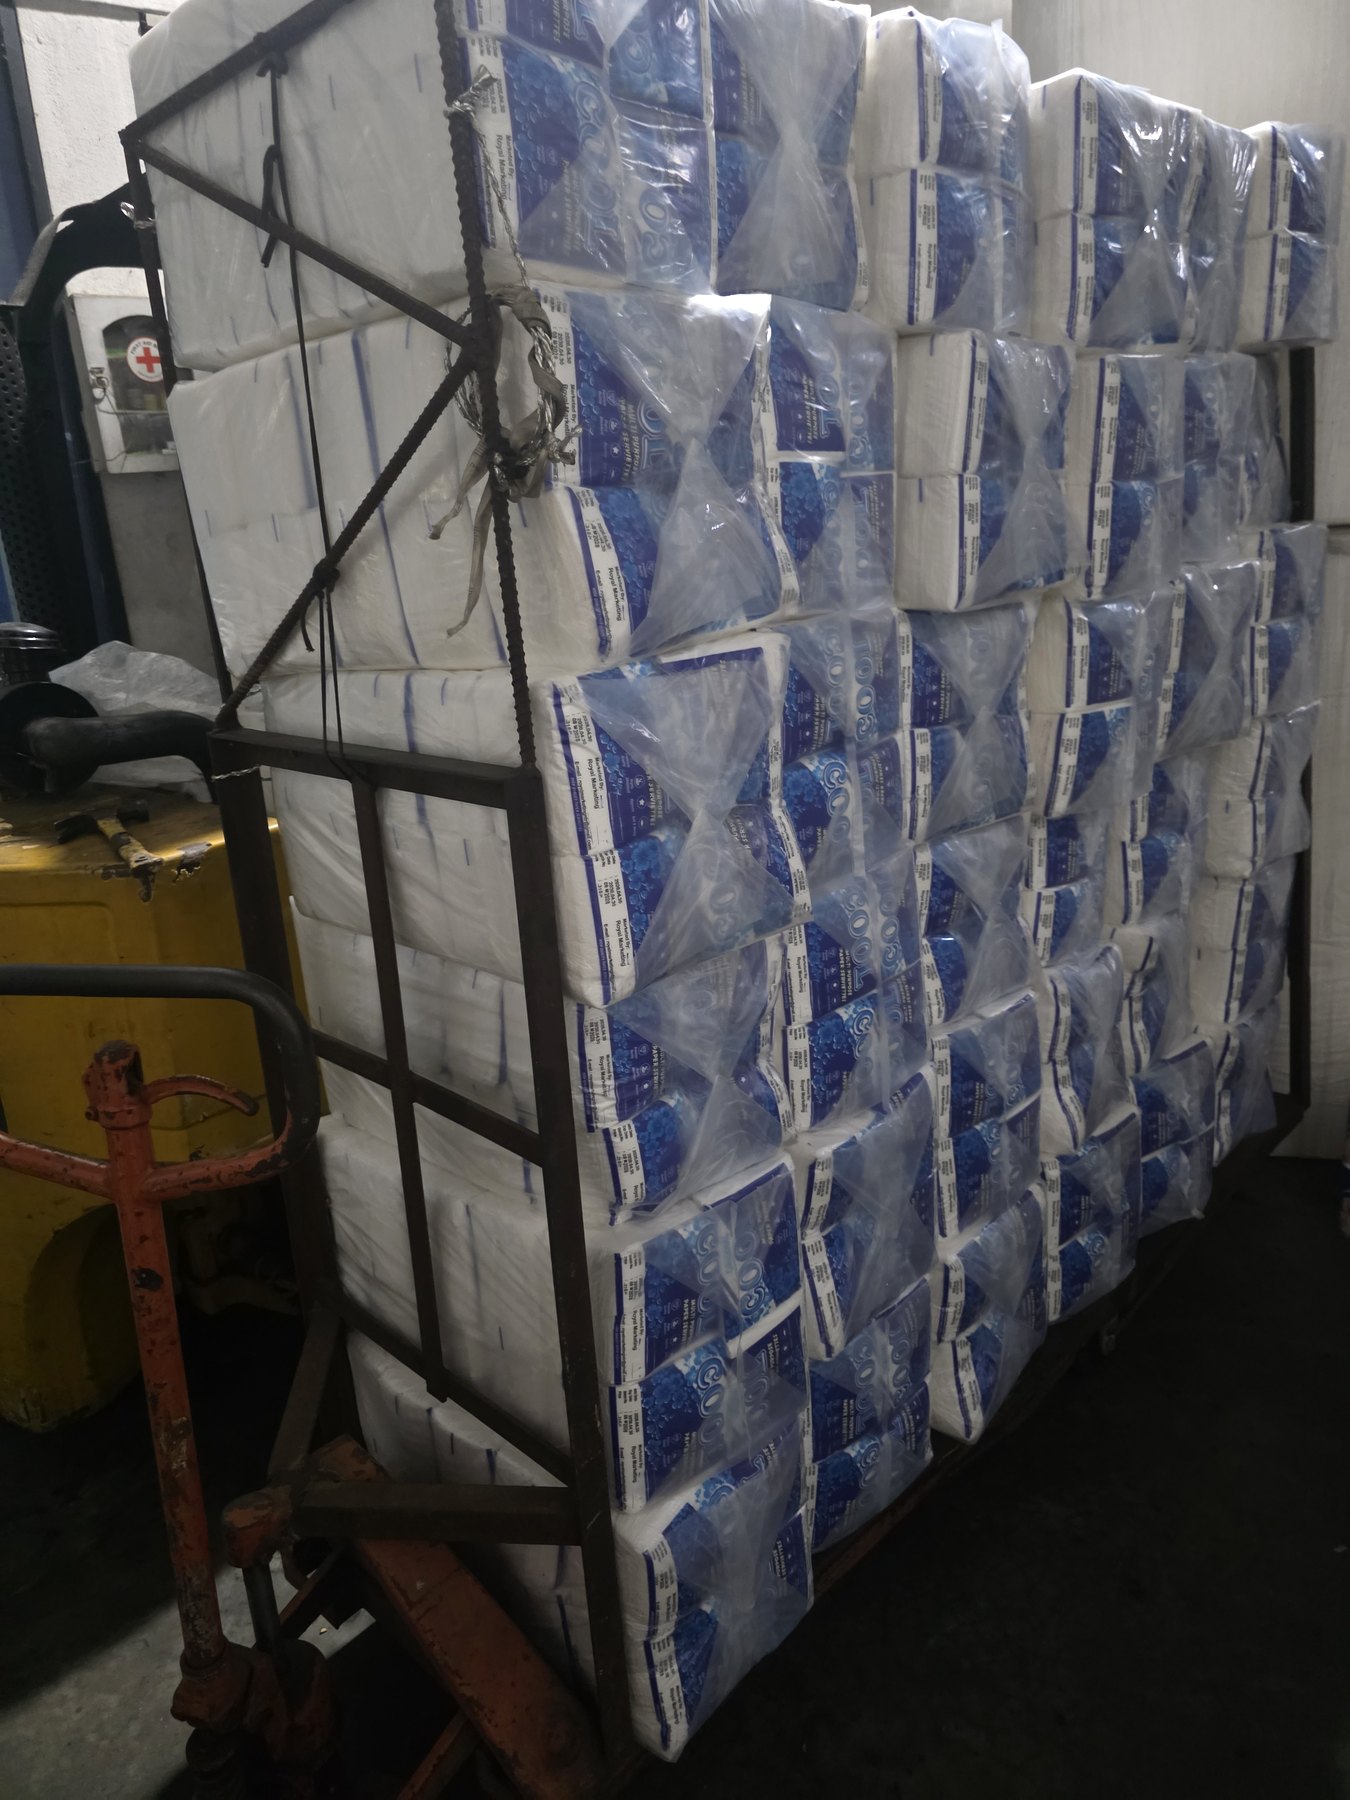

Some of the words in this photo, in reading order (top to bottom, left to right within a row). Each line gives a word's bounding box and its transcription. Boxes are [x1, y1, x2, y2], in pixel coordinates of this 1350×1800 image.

[561, 0, 571, 40] RPOSE
[496, 134, 506, 158] Royal
[499, 159, 509, 201] Marketing
[608, 567, 617, 587] Royal
[611, 588, 623, 622] Marketing
[587, 758, 596, 777] Royal
[590, 777, 601, 810] Marketing
[615, 920, 623, 937] Royal
[844, 886, 874, 992] COOL
[617, 937, 627, 967] Marketing
[651, 1045, 660, 1067] PAPER
[682, 1298, 690, 1320] PAPER
